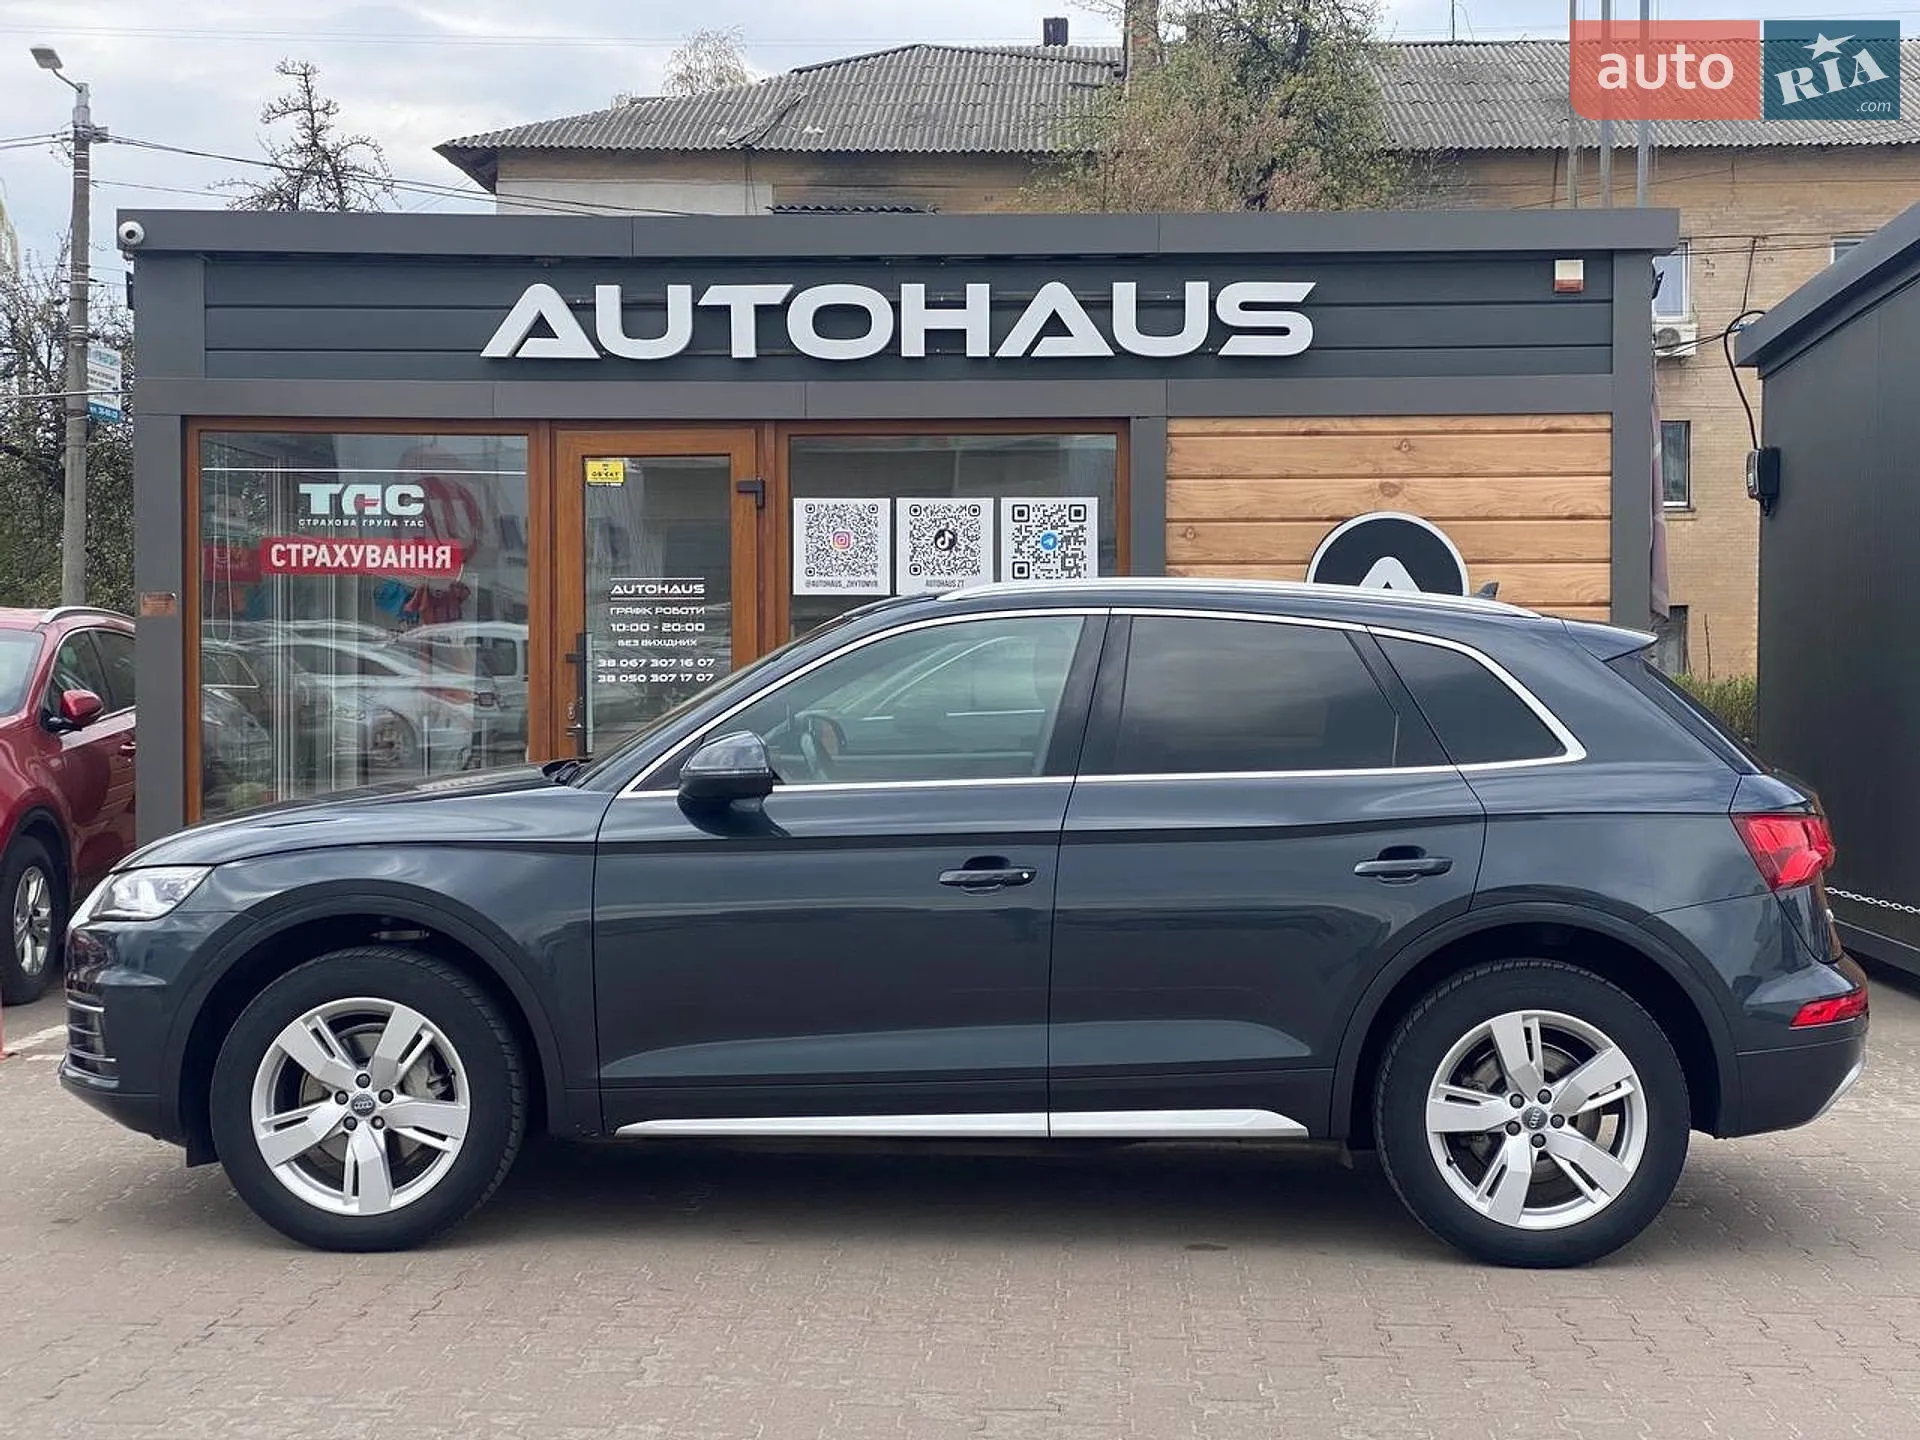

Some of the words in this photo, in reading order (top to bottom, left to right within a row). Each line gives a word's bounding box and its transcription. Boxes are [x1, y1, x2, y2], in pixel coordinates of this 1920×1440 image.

[480, 281, 1317, 360] AUTOHAUS
[298, 518, 357, 528] СТРАХОВА
[362, 519, 398, 528] ГРУПА
[404, 520, 425, 528] ТАС
[271, 543, 452, 569] СТРАХУВАННЯ
[610, 584, 705, 594] AUTOHAUS
[655, 607, 705, 615] РОБОТИ
[610, 622, 650, 632] 10:00
[661, 622, 705, 632] 20:00
[641, 640, 697, 648] ВИХІДНИХ
[598, 659, 616, 667] 38
[619, 659, 647, 667] 067
[650, 659, 677, 667] 307
[680, 659, 694, 667] 16
[697, 659, 716, 667] 07
[598, 674, 616, 683] 38
[619, 674, 647, 683] 050
[650, 674, 677, 683] 307
[680, 674, 693, 683] 17
[696, 673, 714, 682] 07
